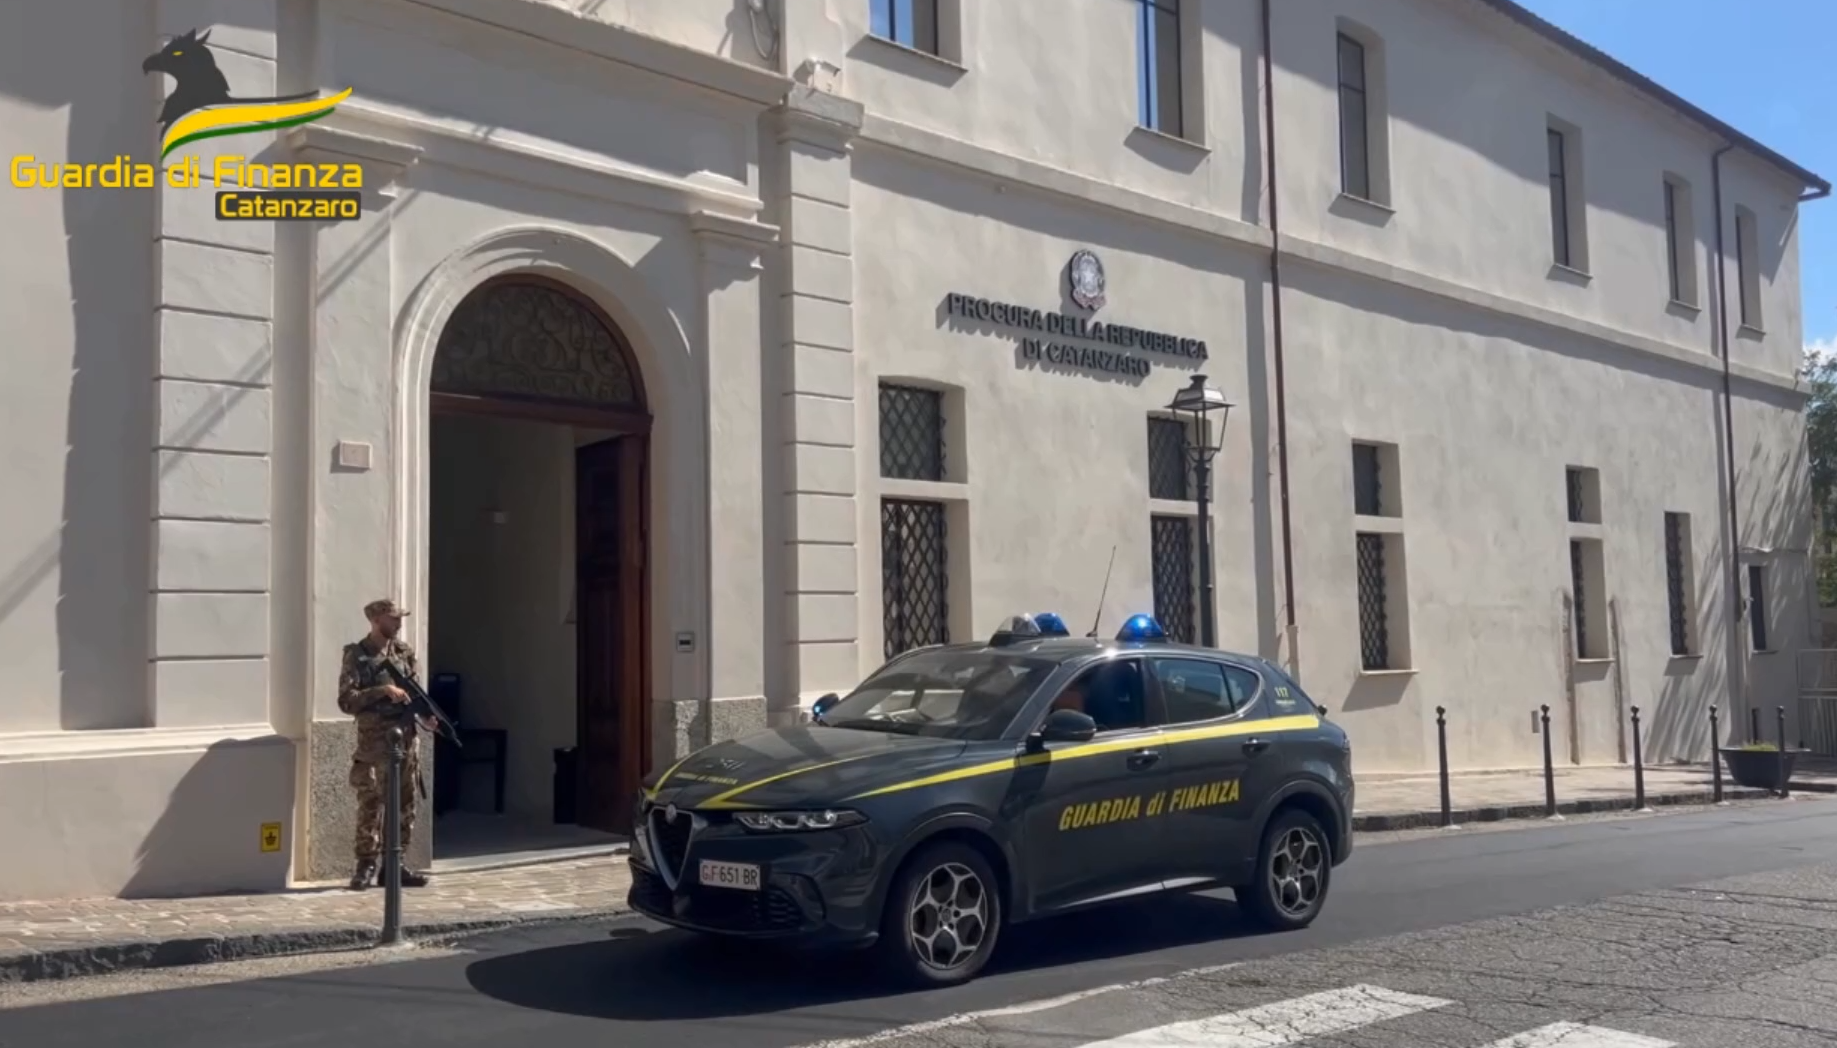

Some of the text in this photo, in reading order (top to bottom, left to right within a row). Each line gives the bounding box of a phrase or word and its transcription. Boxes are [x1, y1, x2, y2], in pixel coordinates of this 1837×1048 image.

[948, 293, 1208, 360] PROCURA DELLA REPUBBLICA
[1023, 338, 1150, 377] DI CATANZARO
[1059, 778, 1240, 831] GUARDIA di FINANZA
[720, 866, 739, 884] 651
[743, 869, 758, 886] BR
